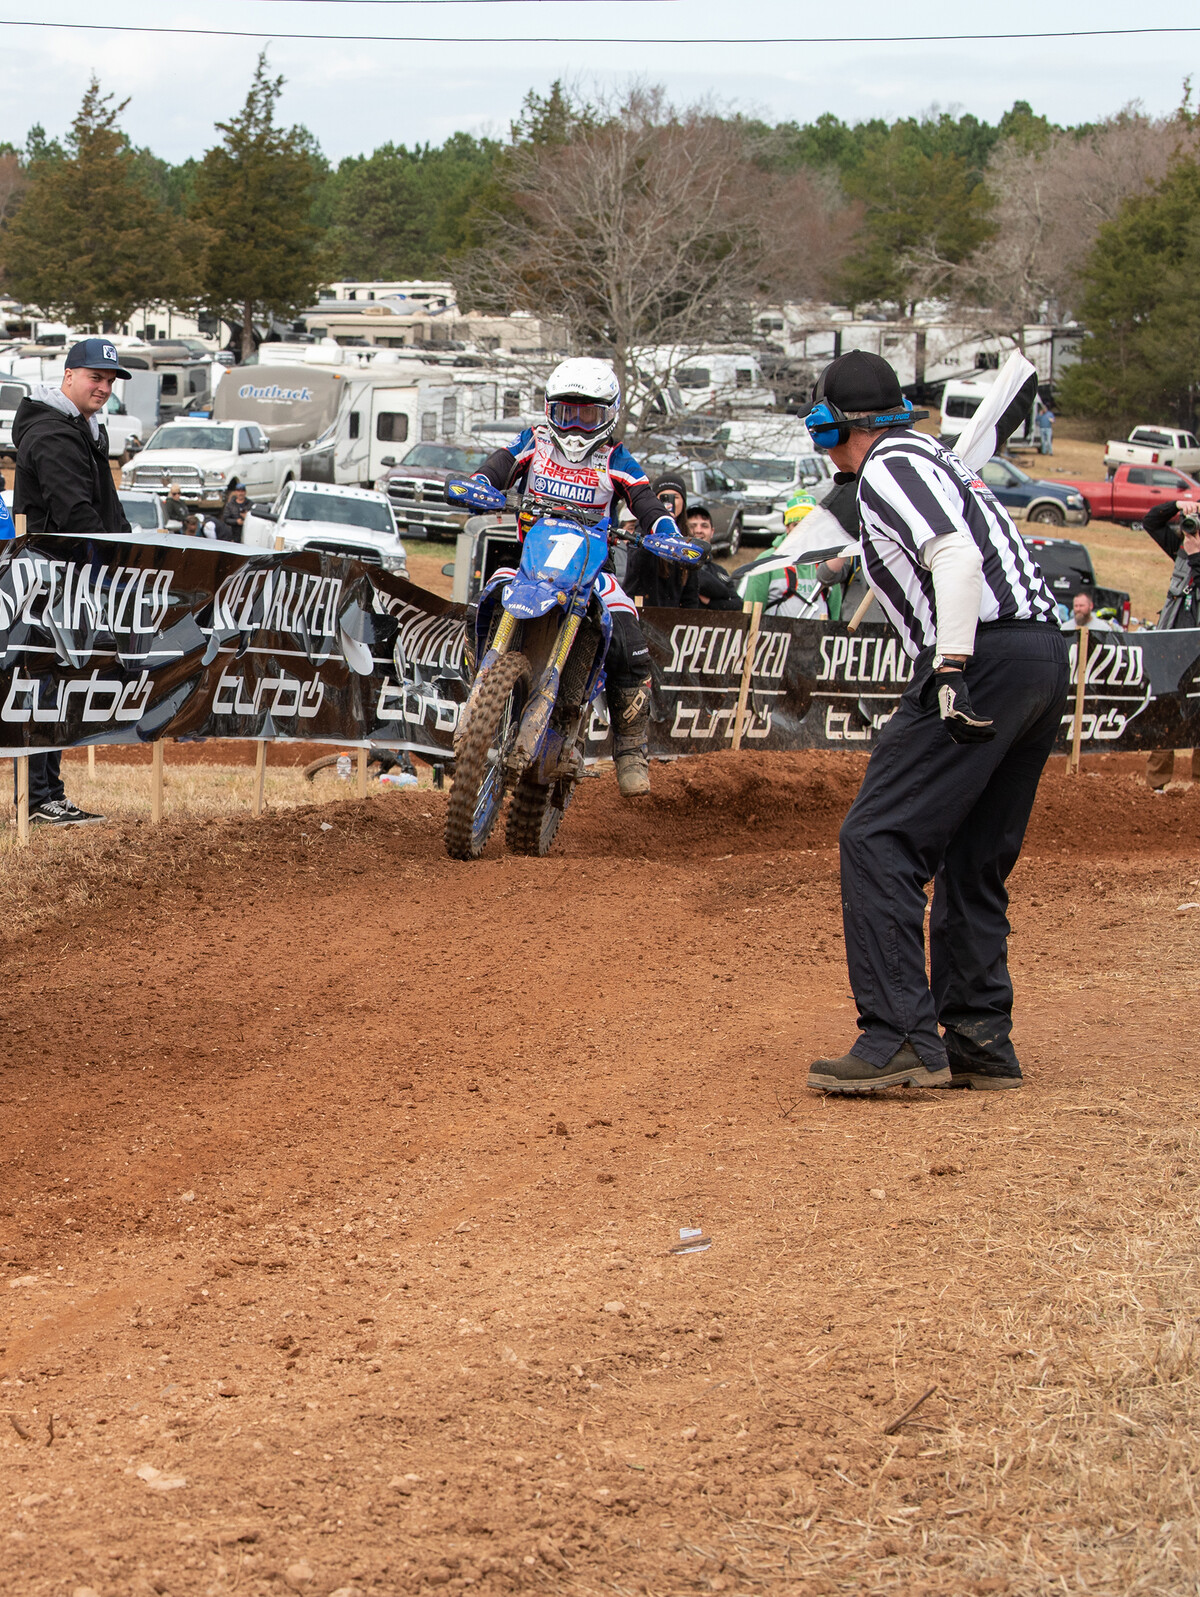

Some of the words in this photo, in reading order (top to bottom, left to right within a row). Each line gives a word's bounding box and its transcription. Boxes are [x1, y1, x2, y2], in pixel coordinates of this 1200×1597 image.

[238, 384, 314, 402] Outback
[543, 466, 599, 487] RACING
[545, 458, 599, 478] MOOSE
[547, 480, 593, 503] YAMAHA
[543, 532, 585, 571] 1
[200, 569, 343, 637] SPECIALIZED
[508, 603, 534, 615] YAMAHA
[1, 666, 155, 723] turbo
[212, 665, 325, 718] turbo
